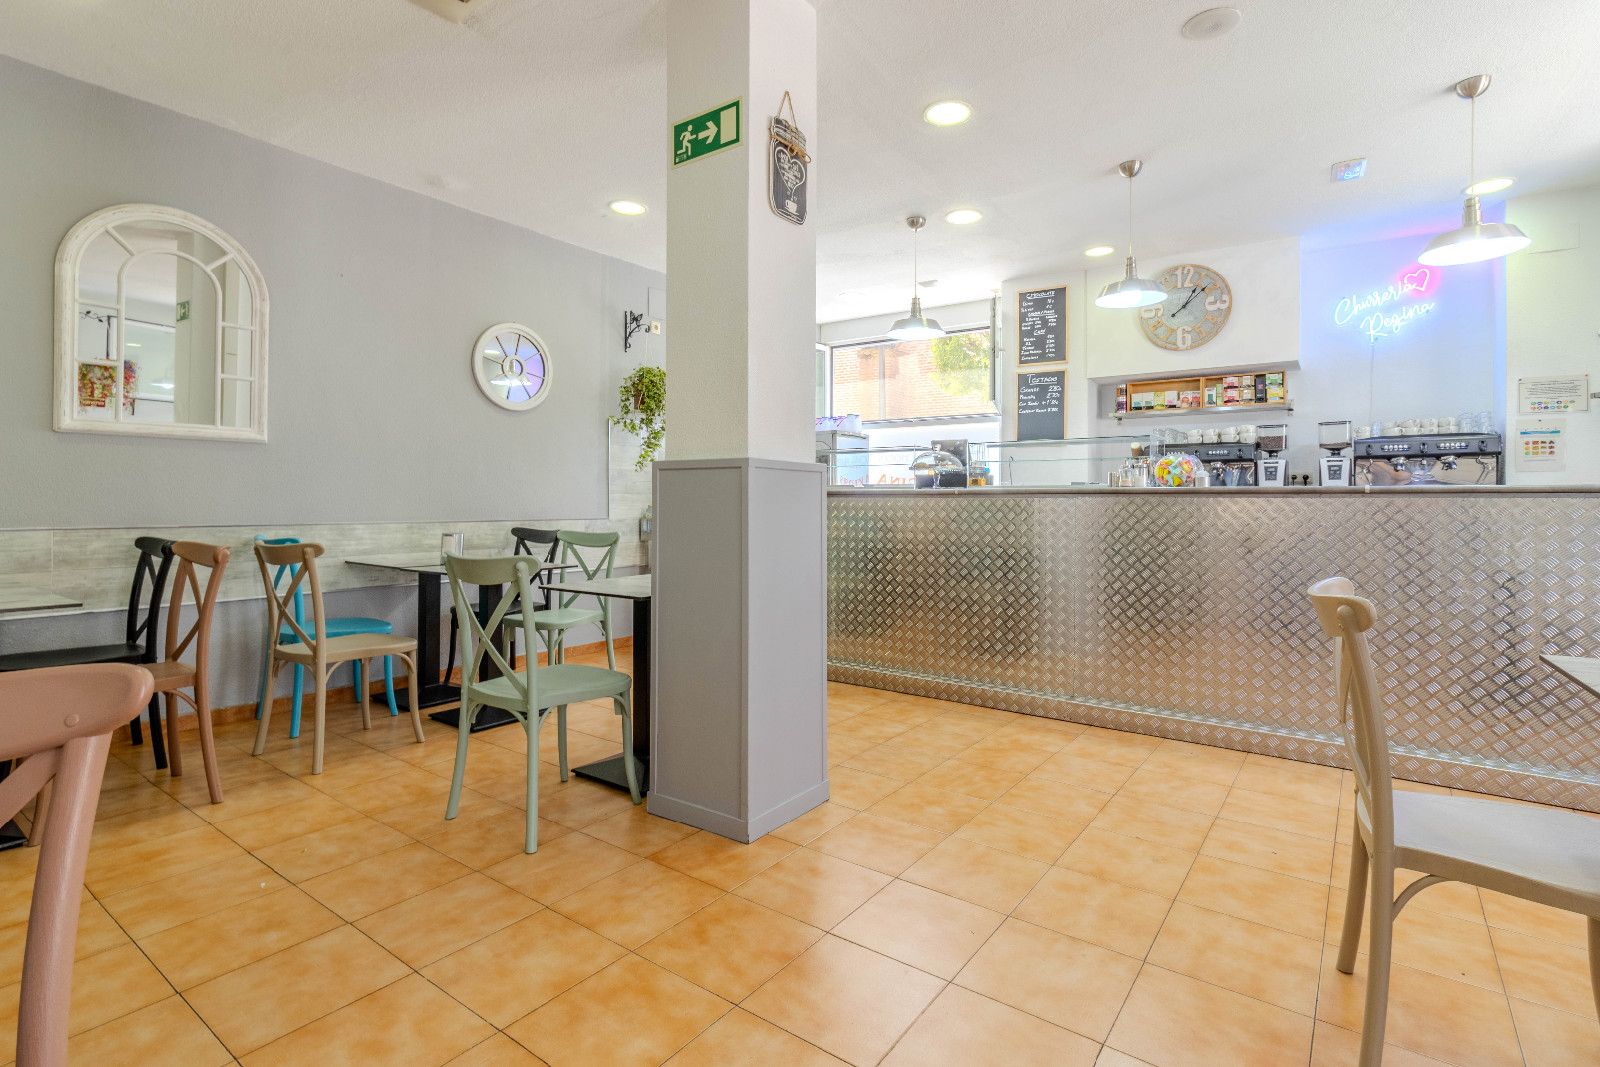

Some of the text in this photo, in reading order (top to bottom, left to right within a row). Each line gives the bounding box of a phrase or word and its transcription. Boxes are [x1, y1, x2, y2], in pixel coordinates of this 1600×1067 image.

[1175, 267, 1194, 289] 12
[1360, 303, 1435, 343] Regina
[1177, 326, 1193, 348] 6
